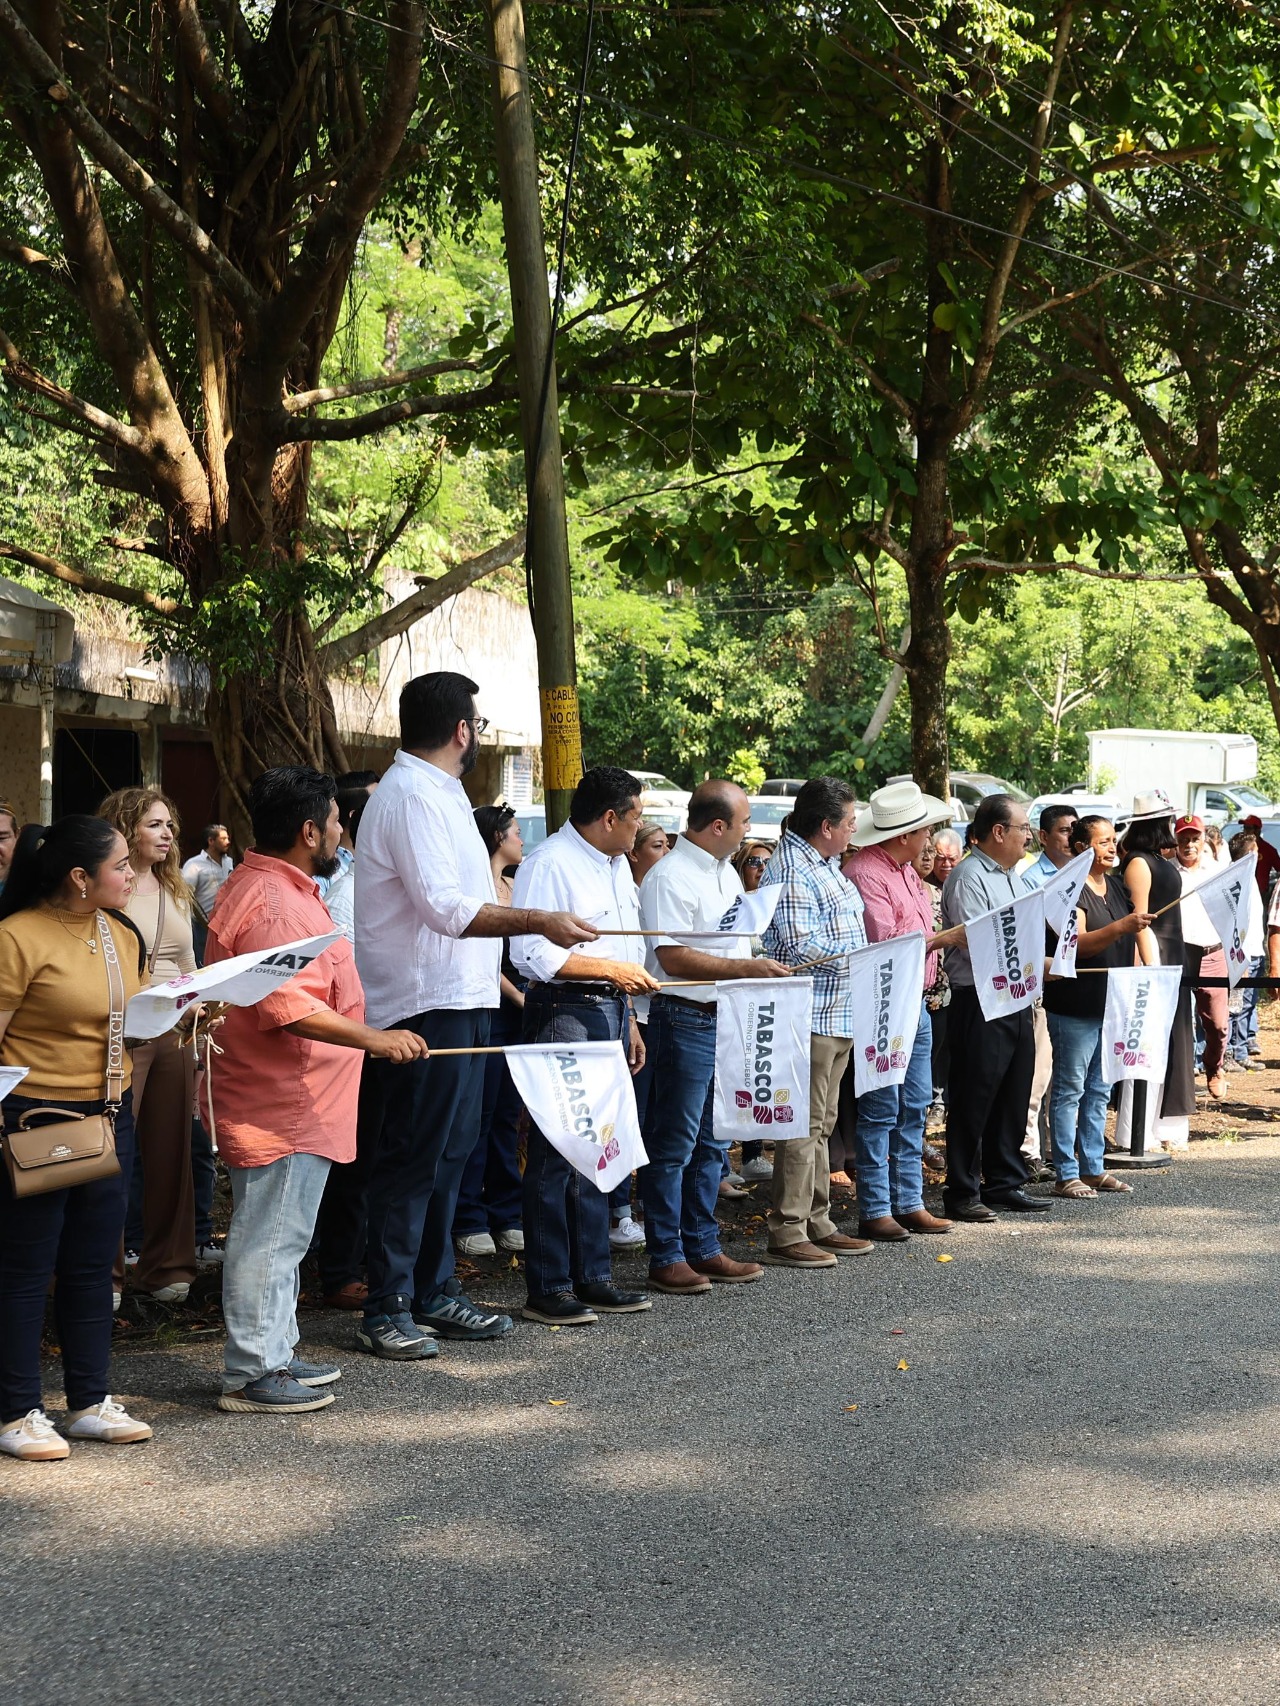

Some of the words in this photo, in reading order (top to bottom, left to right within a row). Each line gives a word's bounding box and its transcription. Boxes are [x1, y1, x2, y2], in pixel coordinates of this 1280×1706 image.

[550, 712, 564, 723] NO
[96, 915, 117, 964] COACH
[999, 906, 1022, 981] TABASCO
[745, 1002, 754, 1041] GOBIERNO
[877, 958, 894, 1053] TABASCO
[1126, 980, 1151, 1050] TABASCO
[110, 1011, 122, 1067] COACH
[745, 1042, 753, 1057] DEL
[754, 1001, 775, 1103] TABASCO
[553, 1083, 563, 1101] DEL
[744, 1058, 753, 1088] PUEBLO
